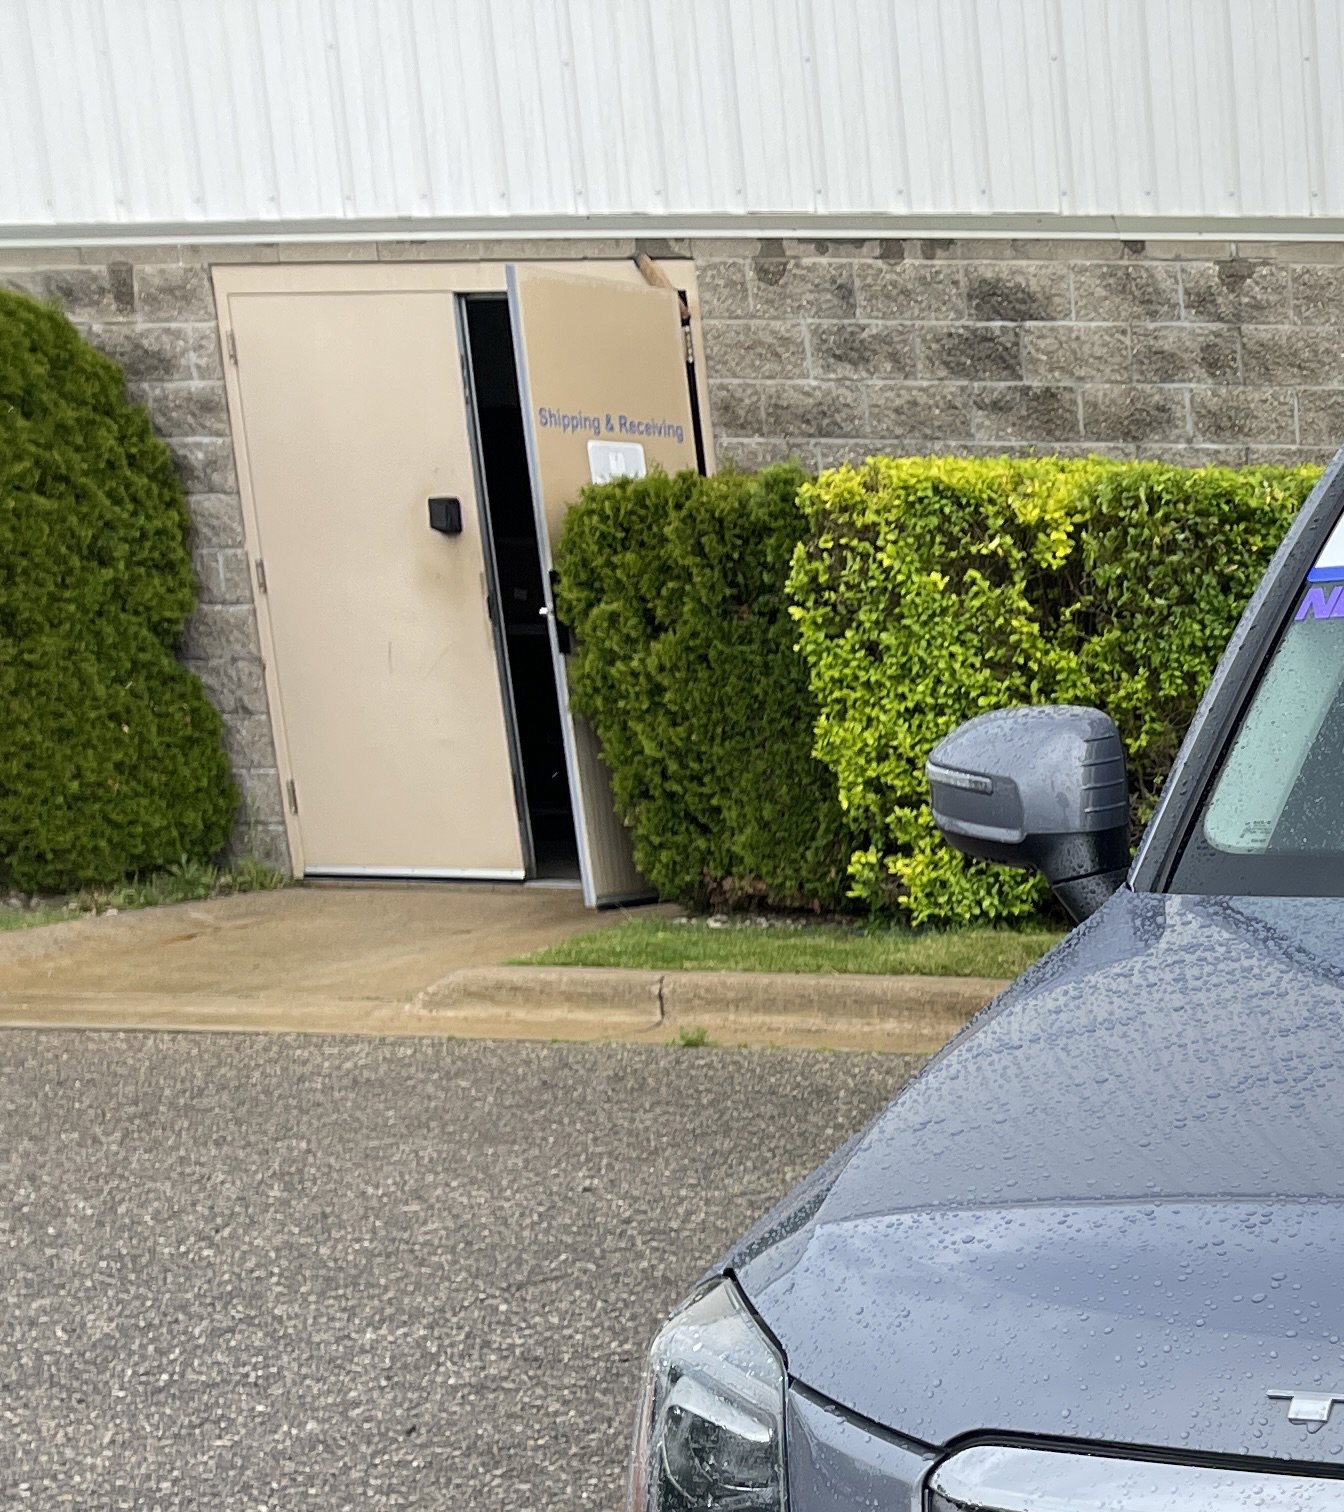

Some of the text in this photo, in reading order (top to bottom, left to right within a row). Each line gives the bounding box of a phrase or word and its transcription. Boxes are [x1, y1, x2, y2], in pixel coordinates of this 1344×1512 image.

[538, 406, 684, 443] Shipping & Receiving
